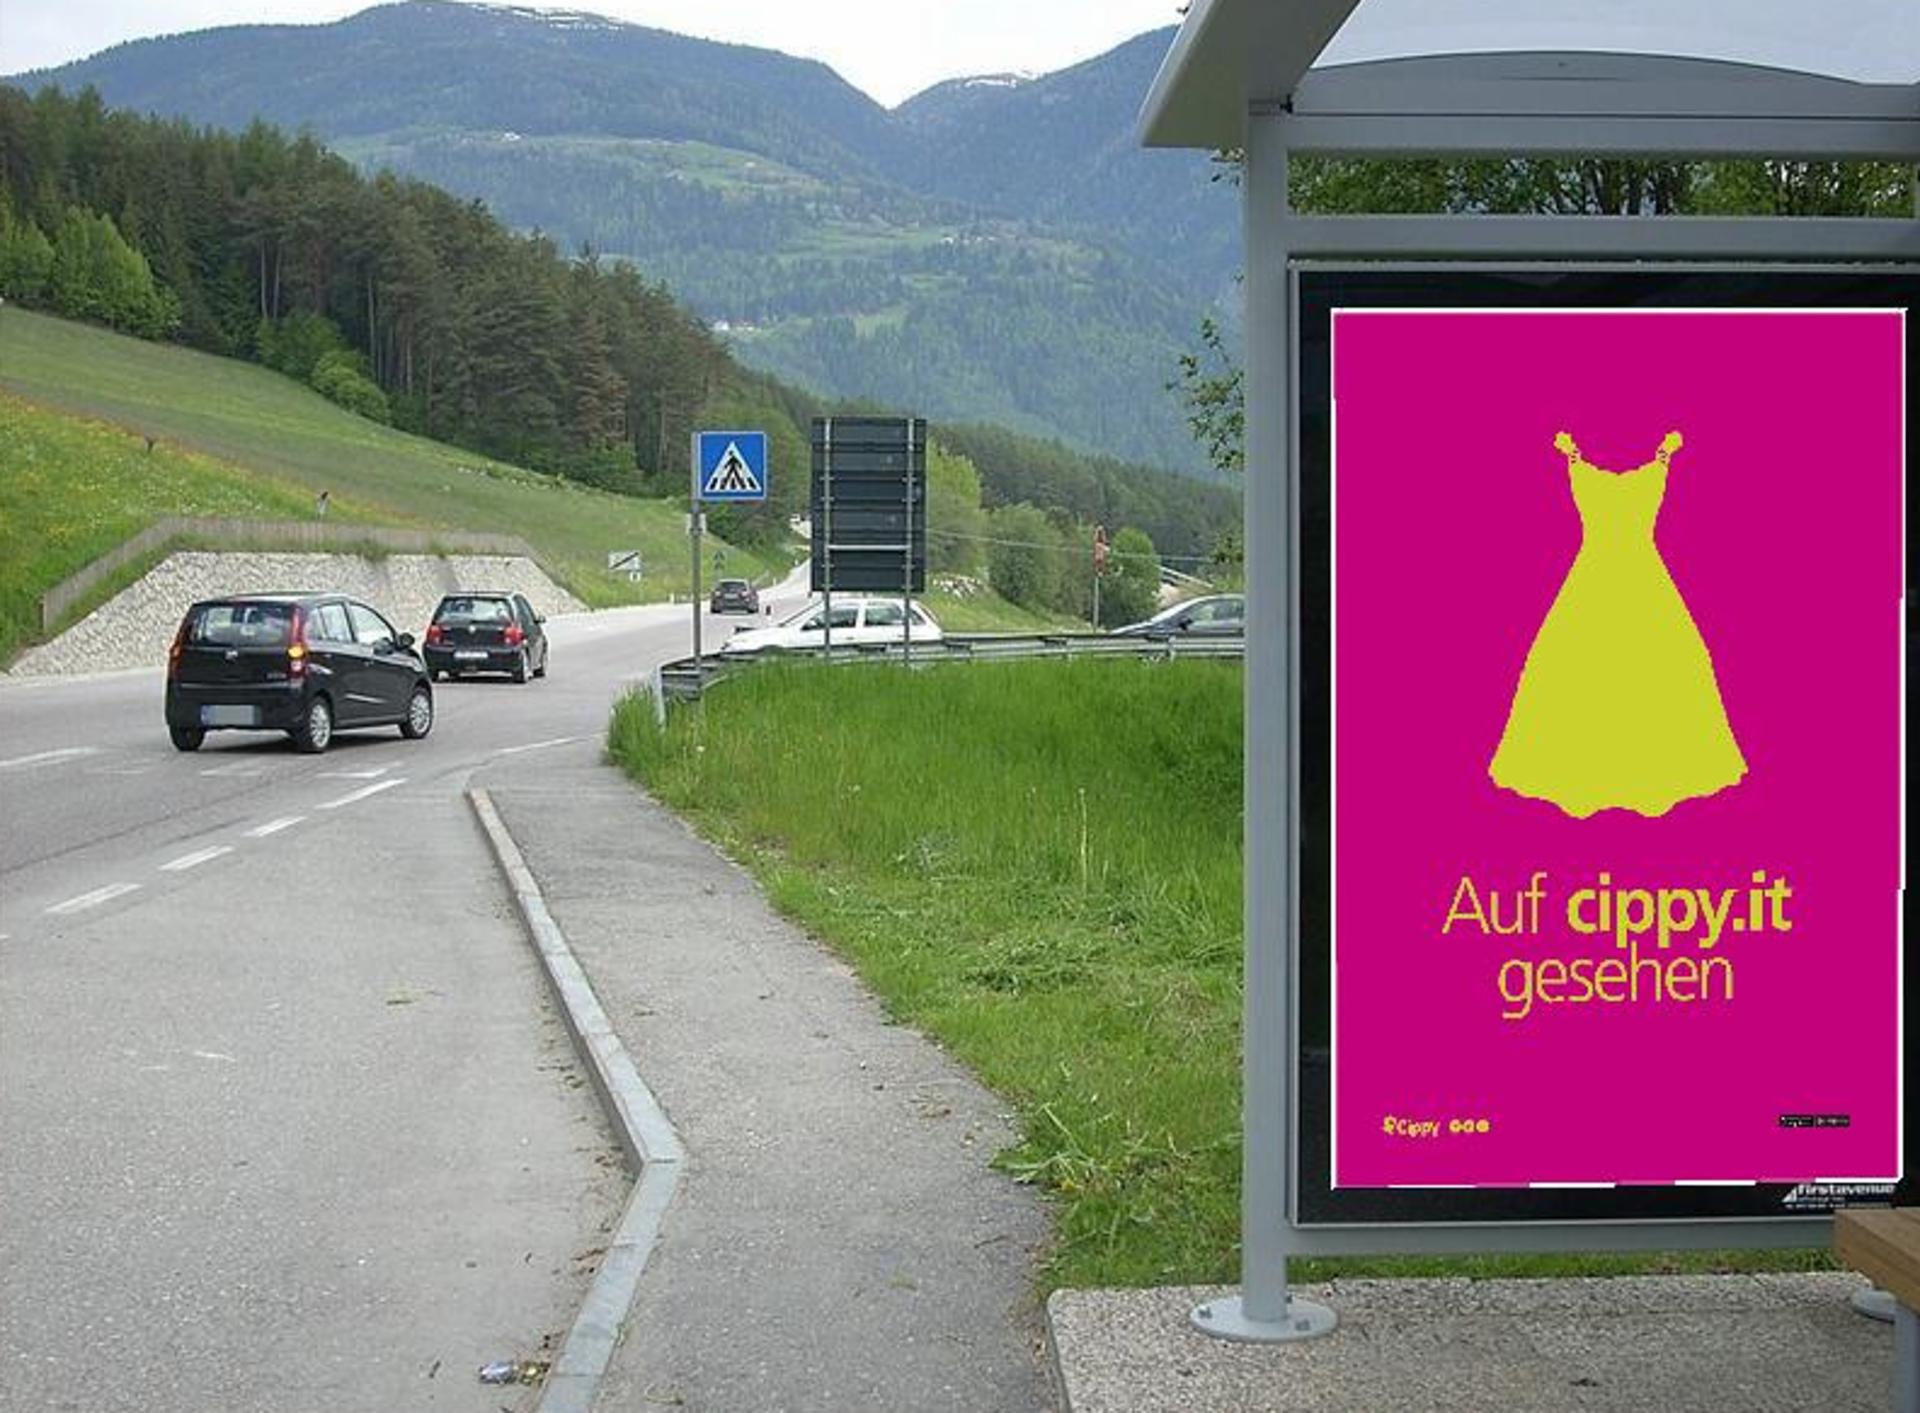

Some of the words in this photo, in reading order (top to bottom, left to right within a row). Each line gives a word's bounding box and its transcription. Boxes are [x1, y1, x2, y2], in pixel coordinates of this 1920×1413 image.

[1442, 871, 1548, 935] Auf
[1566, 869, 1793, 949] cippy.it
[1497, 940, 1734, 1019] gesehen
